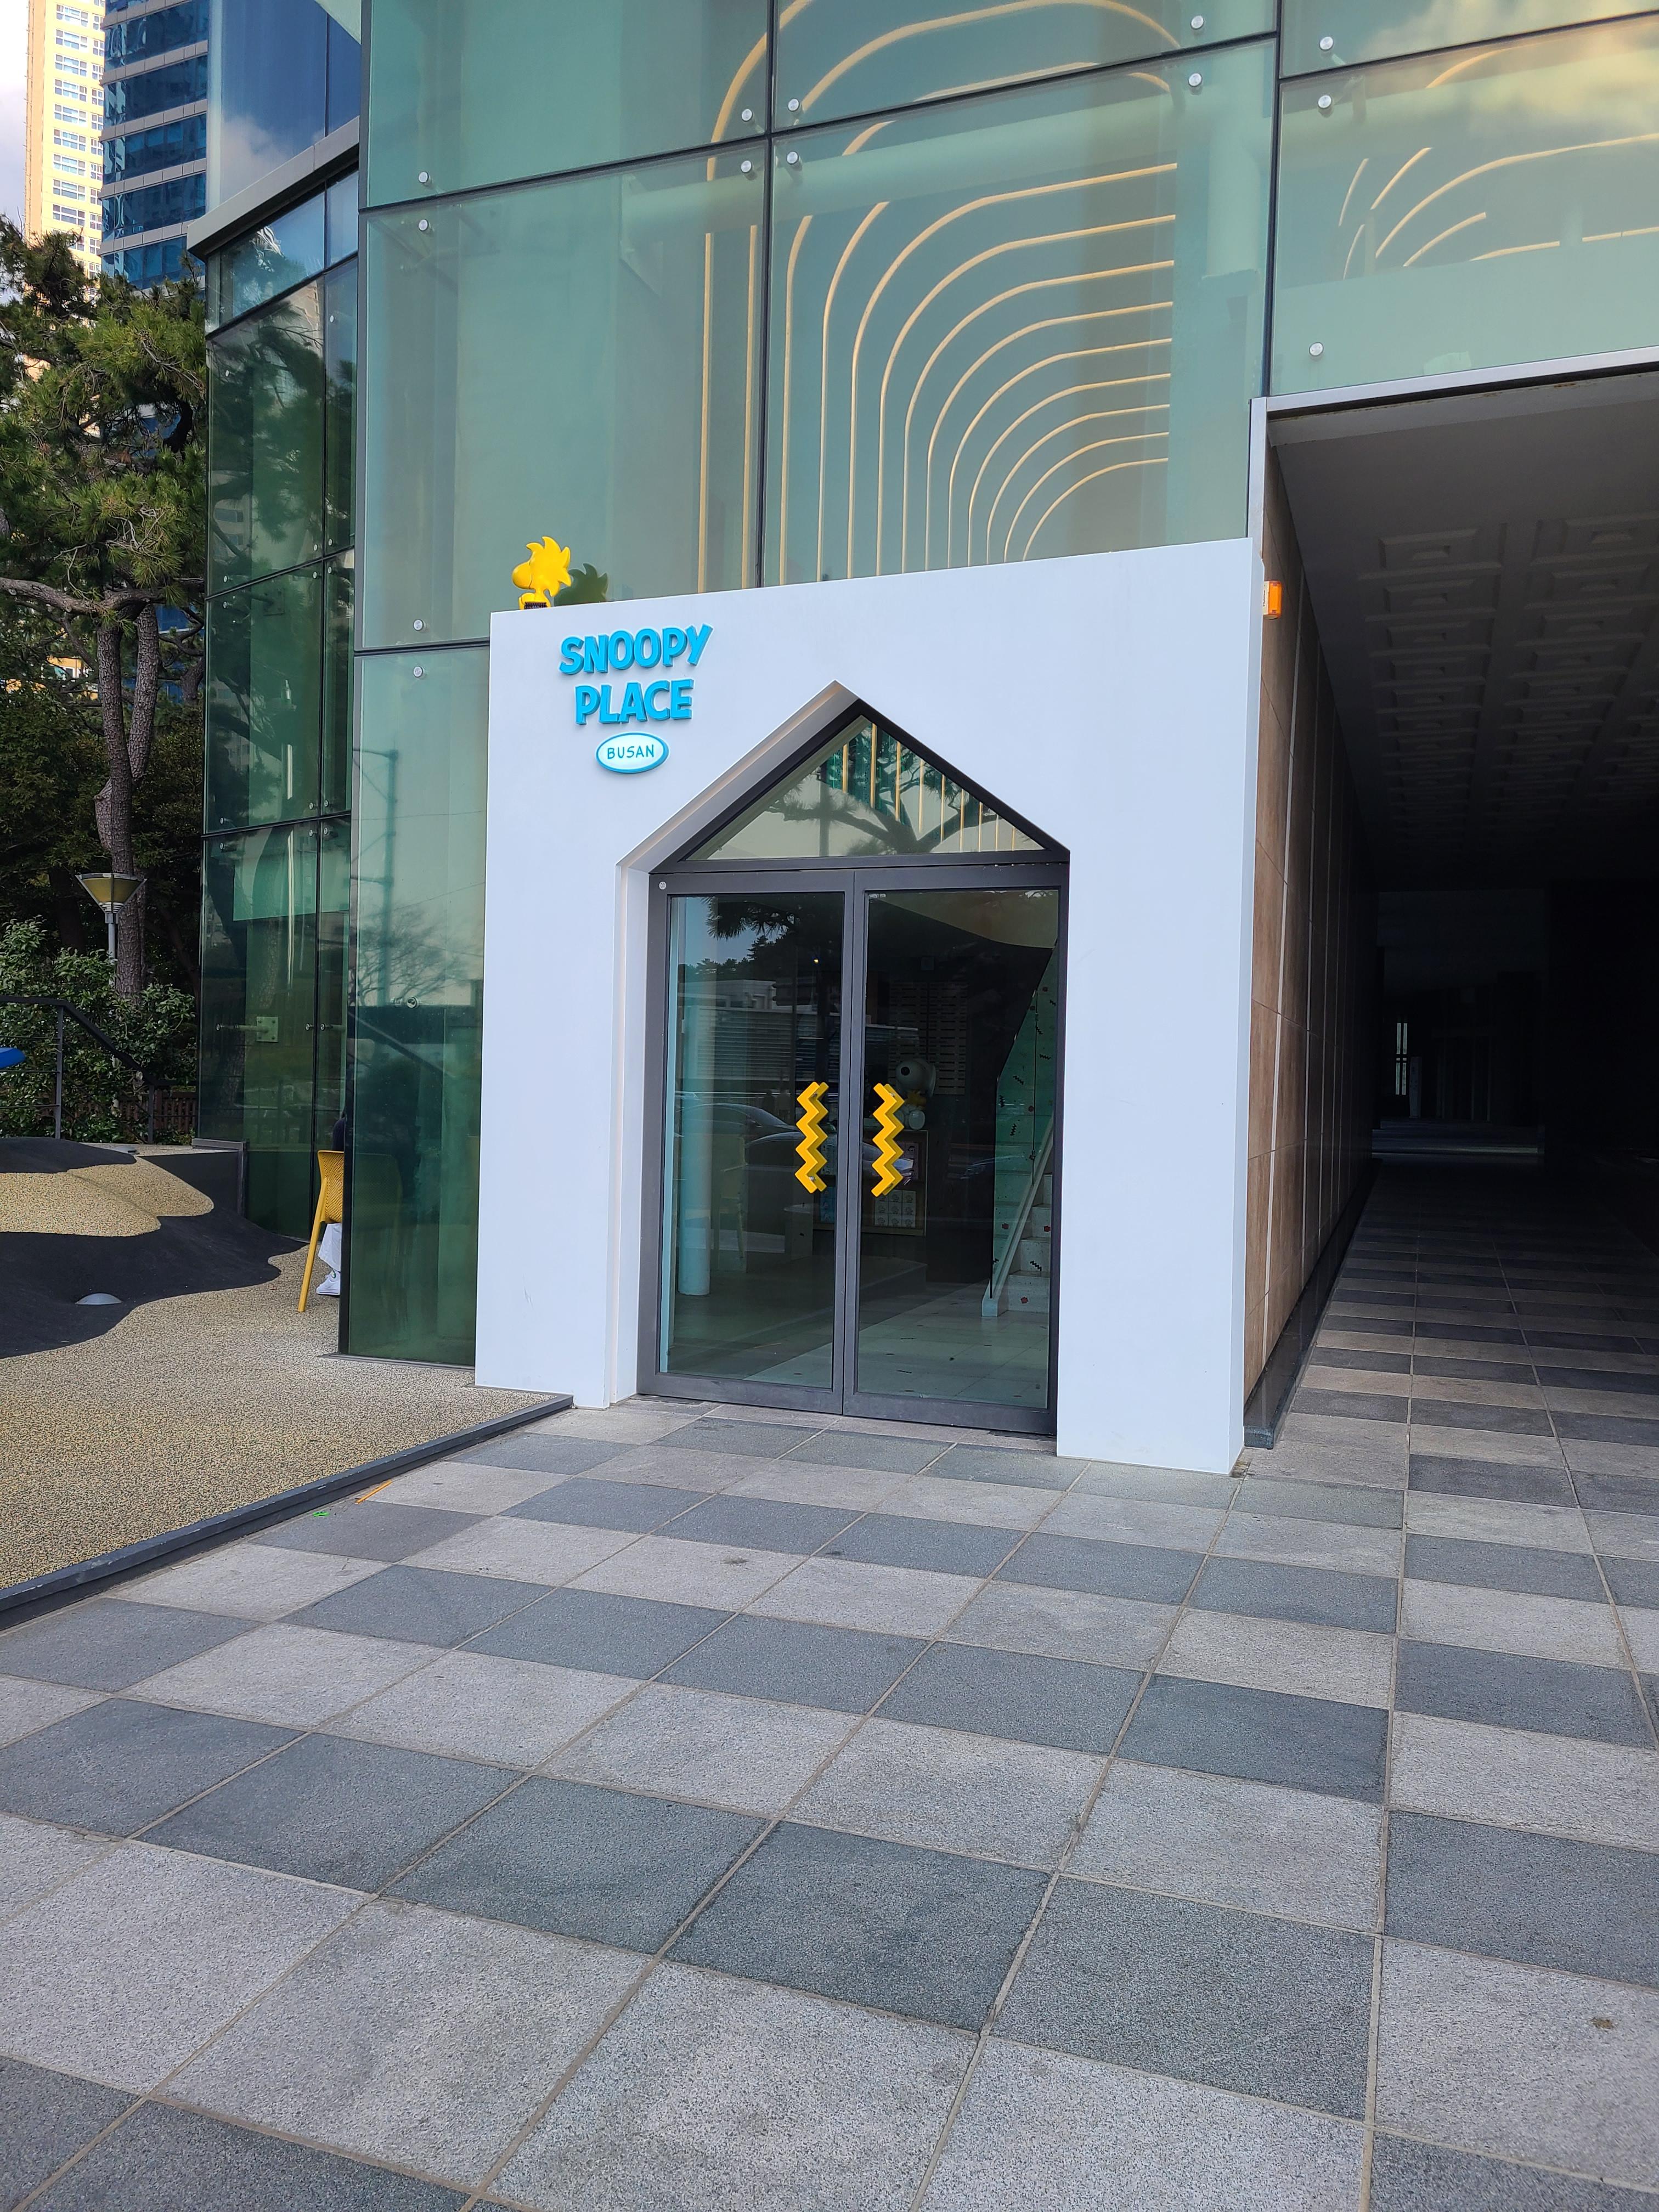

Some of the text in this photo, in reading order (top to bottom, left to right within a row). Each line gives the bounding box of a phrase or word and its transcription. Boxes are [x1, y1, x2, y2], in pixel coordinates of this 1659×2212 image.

[559, 624, 713, 675] SNOOPY
[575, 679, 694, 725] PLACE
[607, 744, 655, 760] BUSAN
